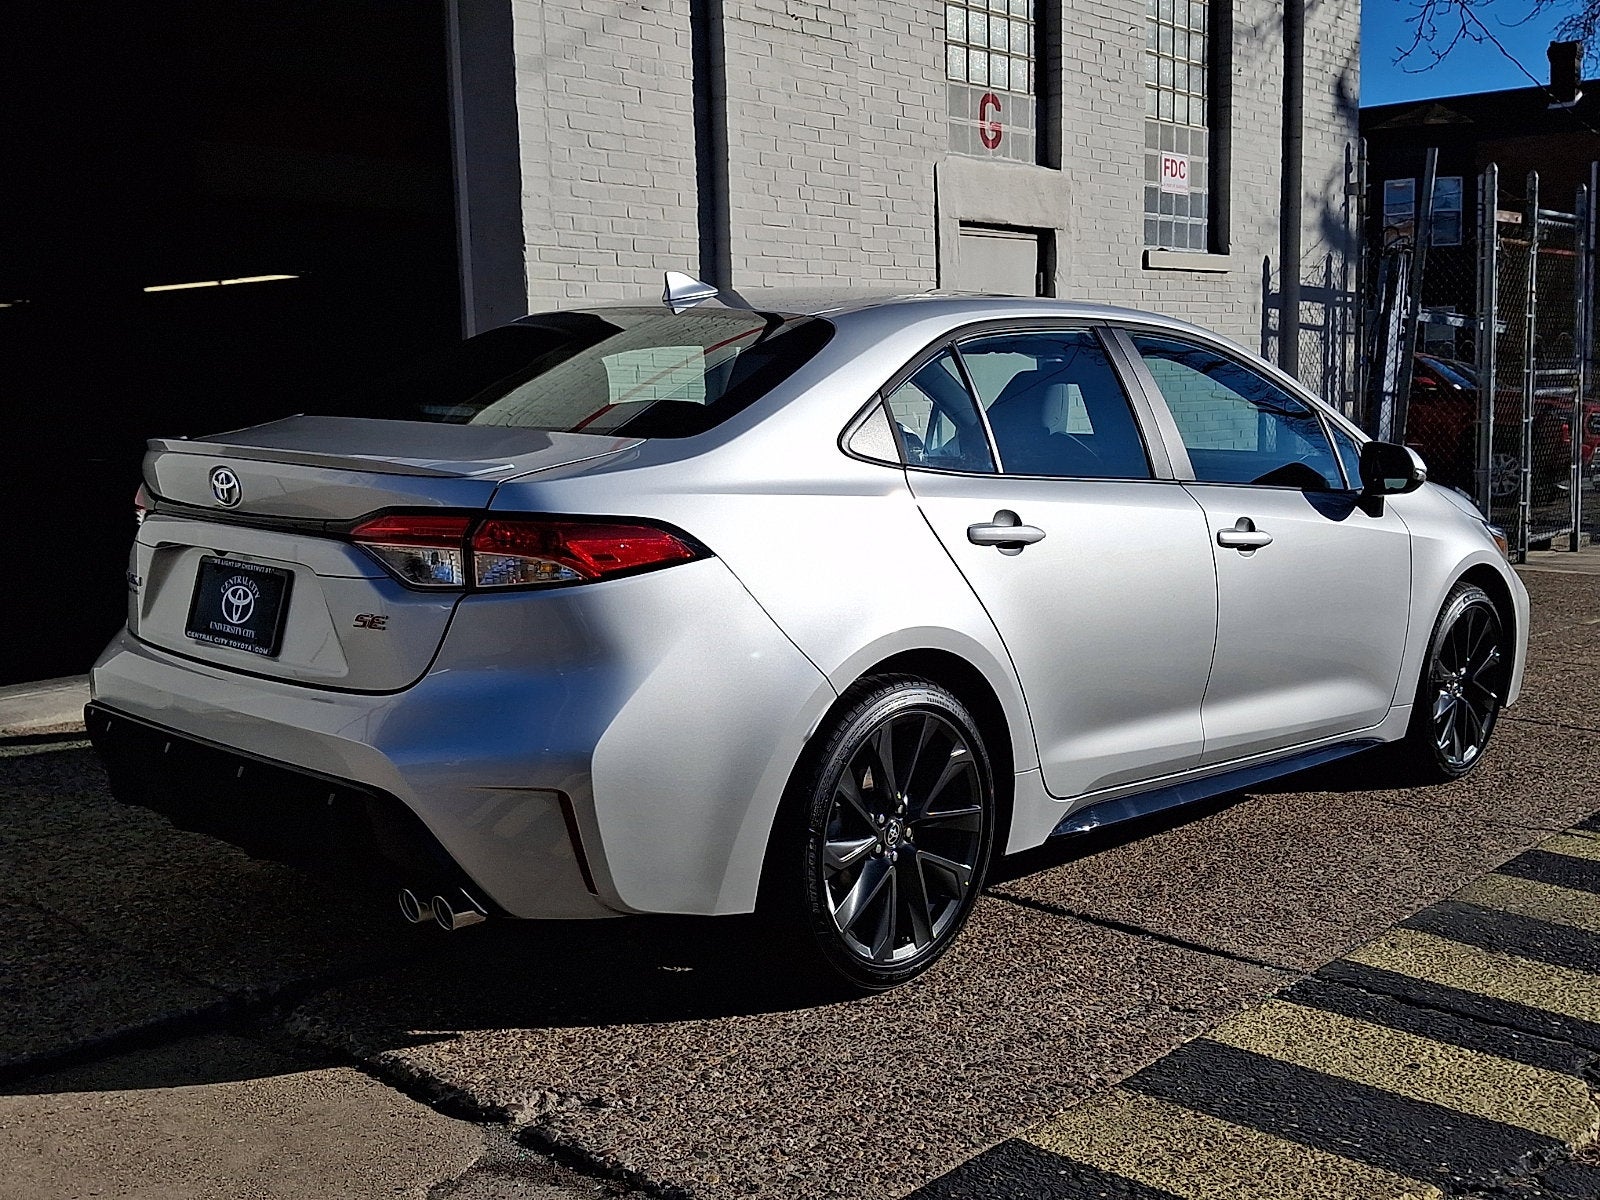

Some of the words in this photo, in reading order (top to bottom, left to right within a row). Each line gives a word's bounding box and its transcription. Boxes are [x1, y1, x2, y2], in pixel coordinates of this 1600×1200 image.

[979, 92, 1002, 149] G
[1164, 158, 1186, 179] FDC
[221, 576, 249, 594] CENTRAL
[248, 580, 261, 599] CITY
[209, 621, 242, 636] UNIVERSITY
[242, 628, 255, 639] CITY
[352, 613, 389, 631] SE
[186, 631, 213, 642] CENTRAL
[214, 637, 228, 645] CITY
